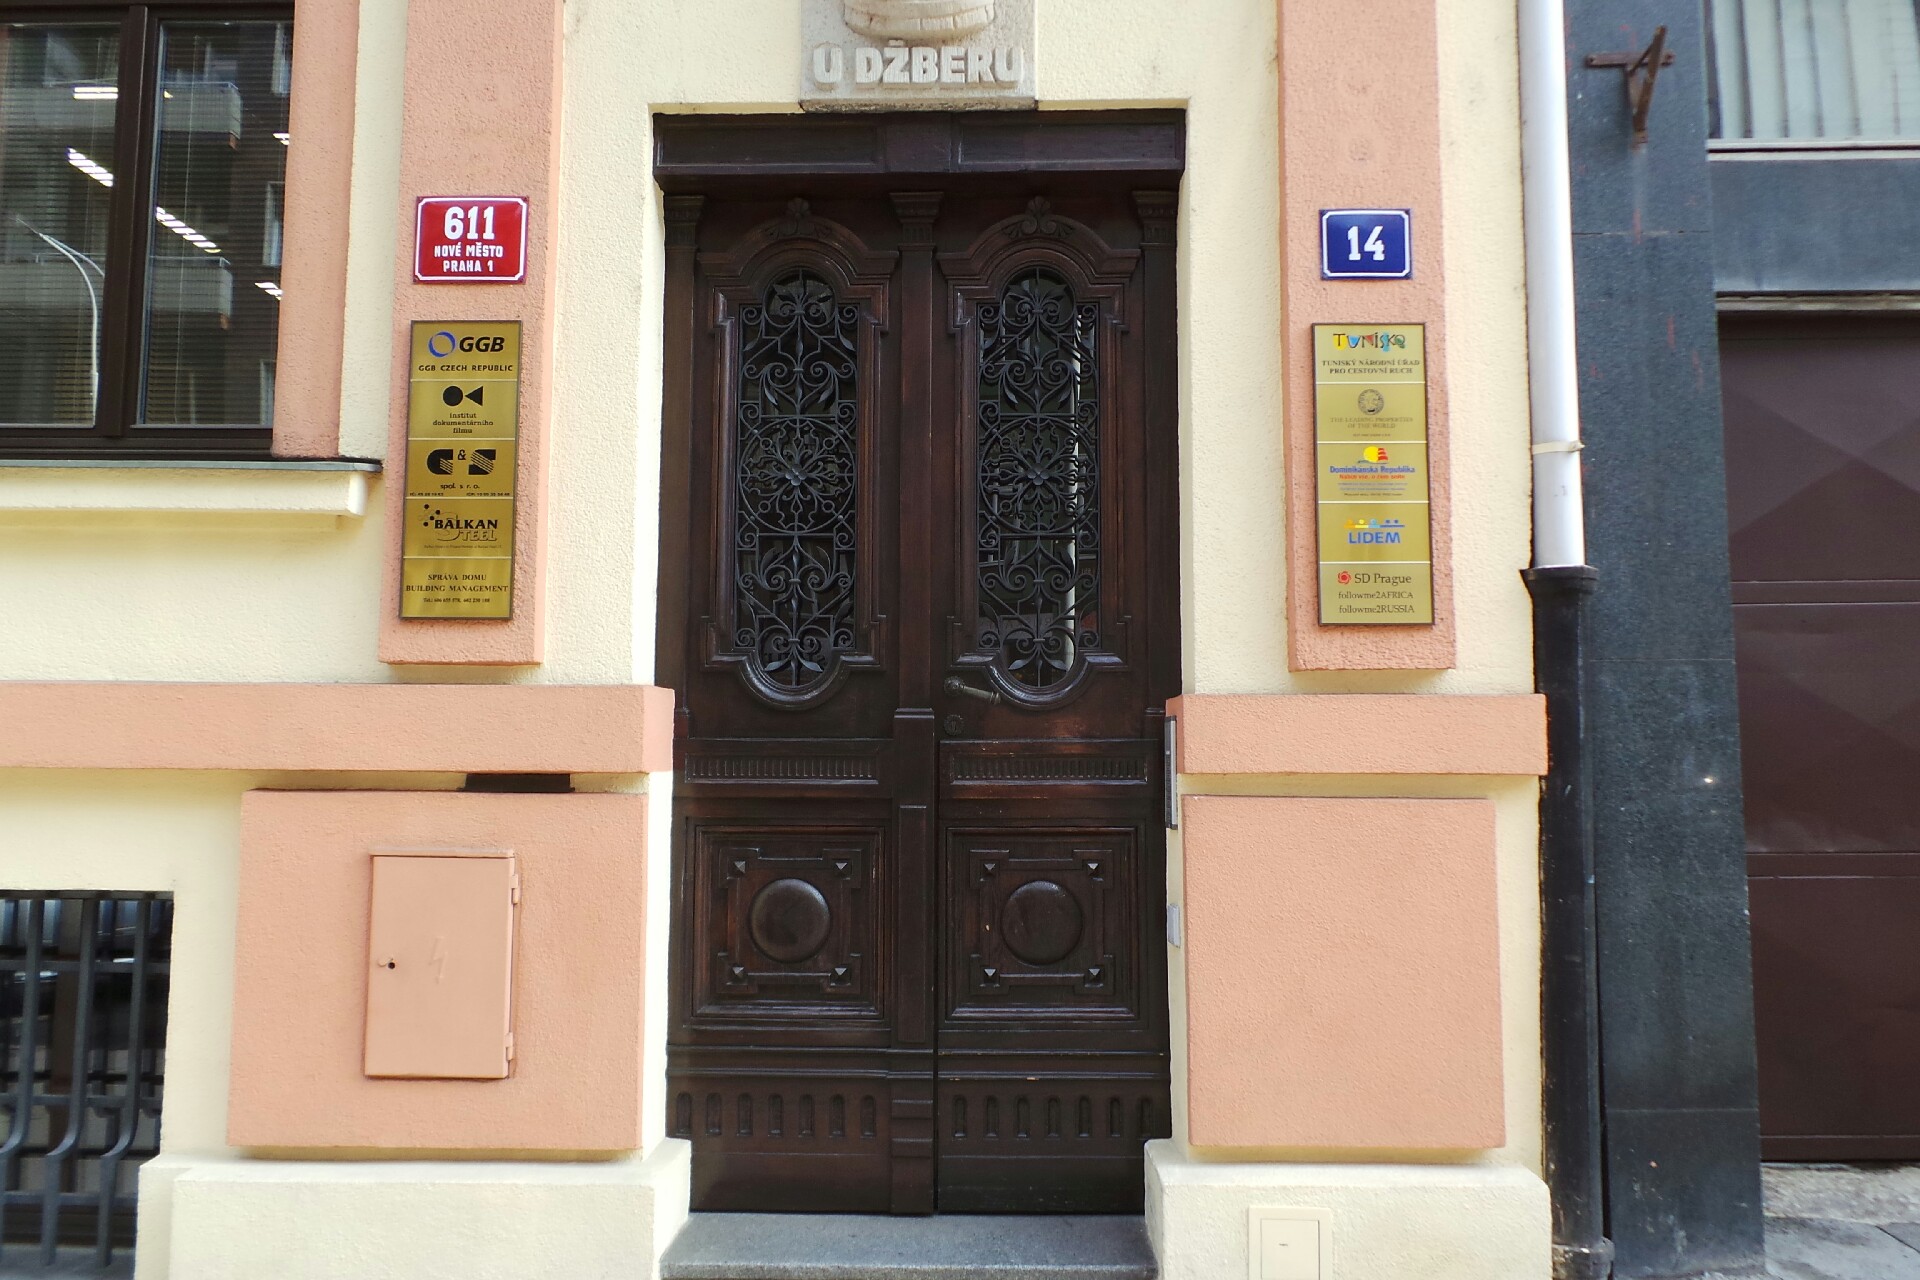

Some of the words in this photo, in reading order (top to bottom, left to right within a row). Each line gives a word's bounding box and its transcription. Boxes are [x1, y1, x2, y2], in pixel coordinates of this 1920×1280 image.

[812, 46, 842, 84] U
[855, 39, 1024, 85] DŽBERU
[444, 206, 495, 240] 611
[1347, 225, 1386, 261] 14
[434, 241, 462, 258] NOVÉ
[465, 241, 504, 258] MĚSTO
[443, 259, 482, 272] PRAHA
[487, 259, 494, 272] 1
[459, 336, 505, 353] GGB
[418, 364, 436, 372] GGB
[440, 364, 467, 372] CZECH
[471, 364, 513, 372] REPUBLIC
[1322, 358, 1357, 367] TUNISKÝ
[1359, 358, 1395, 367] NÁRODNÍ
[1347, 366, 1387, 375] CESTOVNÍ
[1389, 367, 1413, 375] RUCH
[1380, 465, 1416, 475] Republika
[434, 519, 499, 530] BALKAN
[1348, 532, 1401, 545] LIDEM
[428, 573, 459, 581] SPRÁVA
[1354, 573, 1371, 584] SD
[1373, 573, 1413, 587] Prague
[1338, 591, 1414, 600] followme2AFRICA
[1339, 604, 1415, 614] followme2RUSSIA
